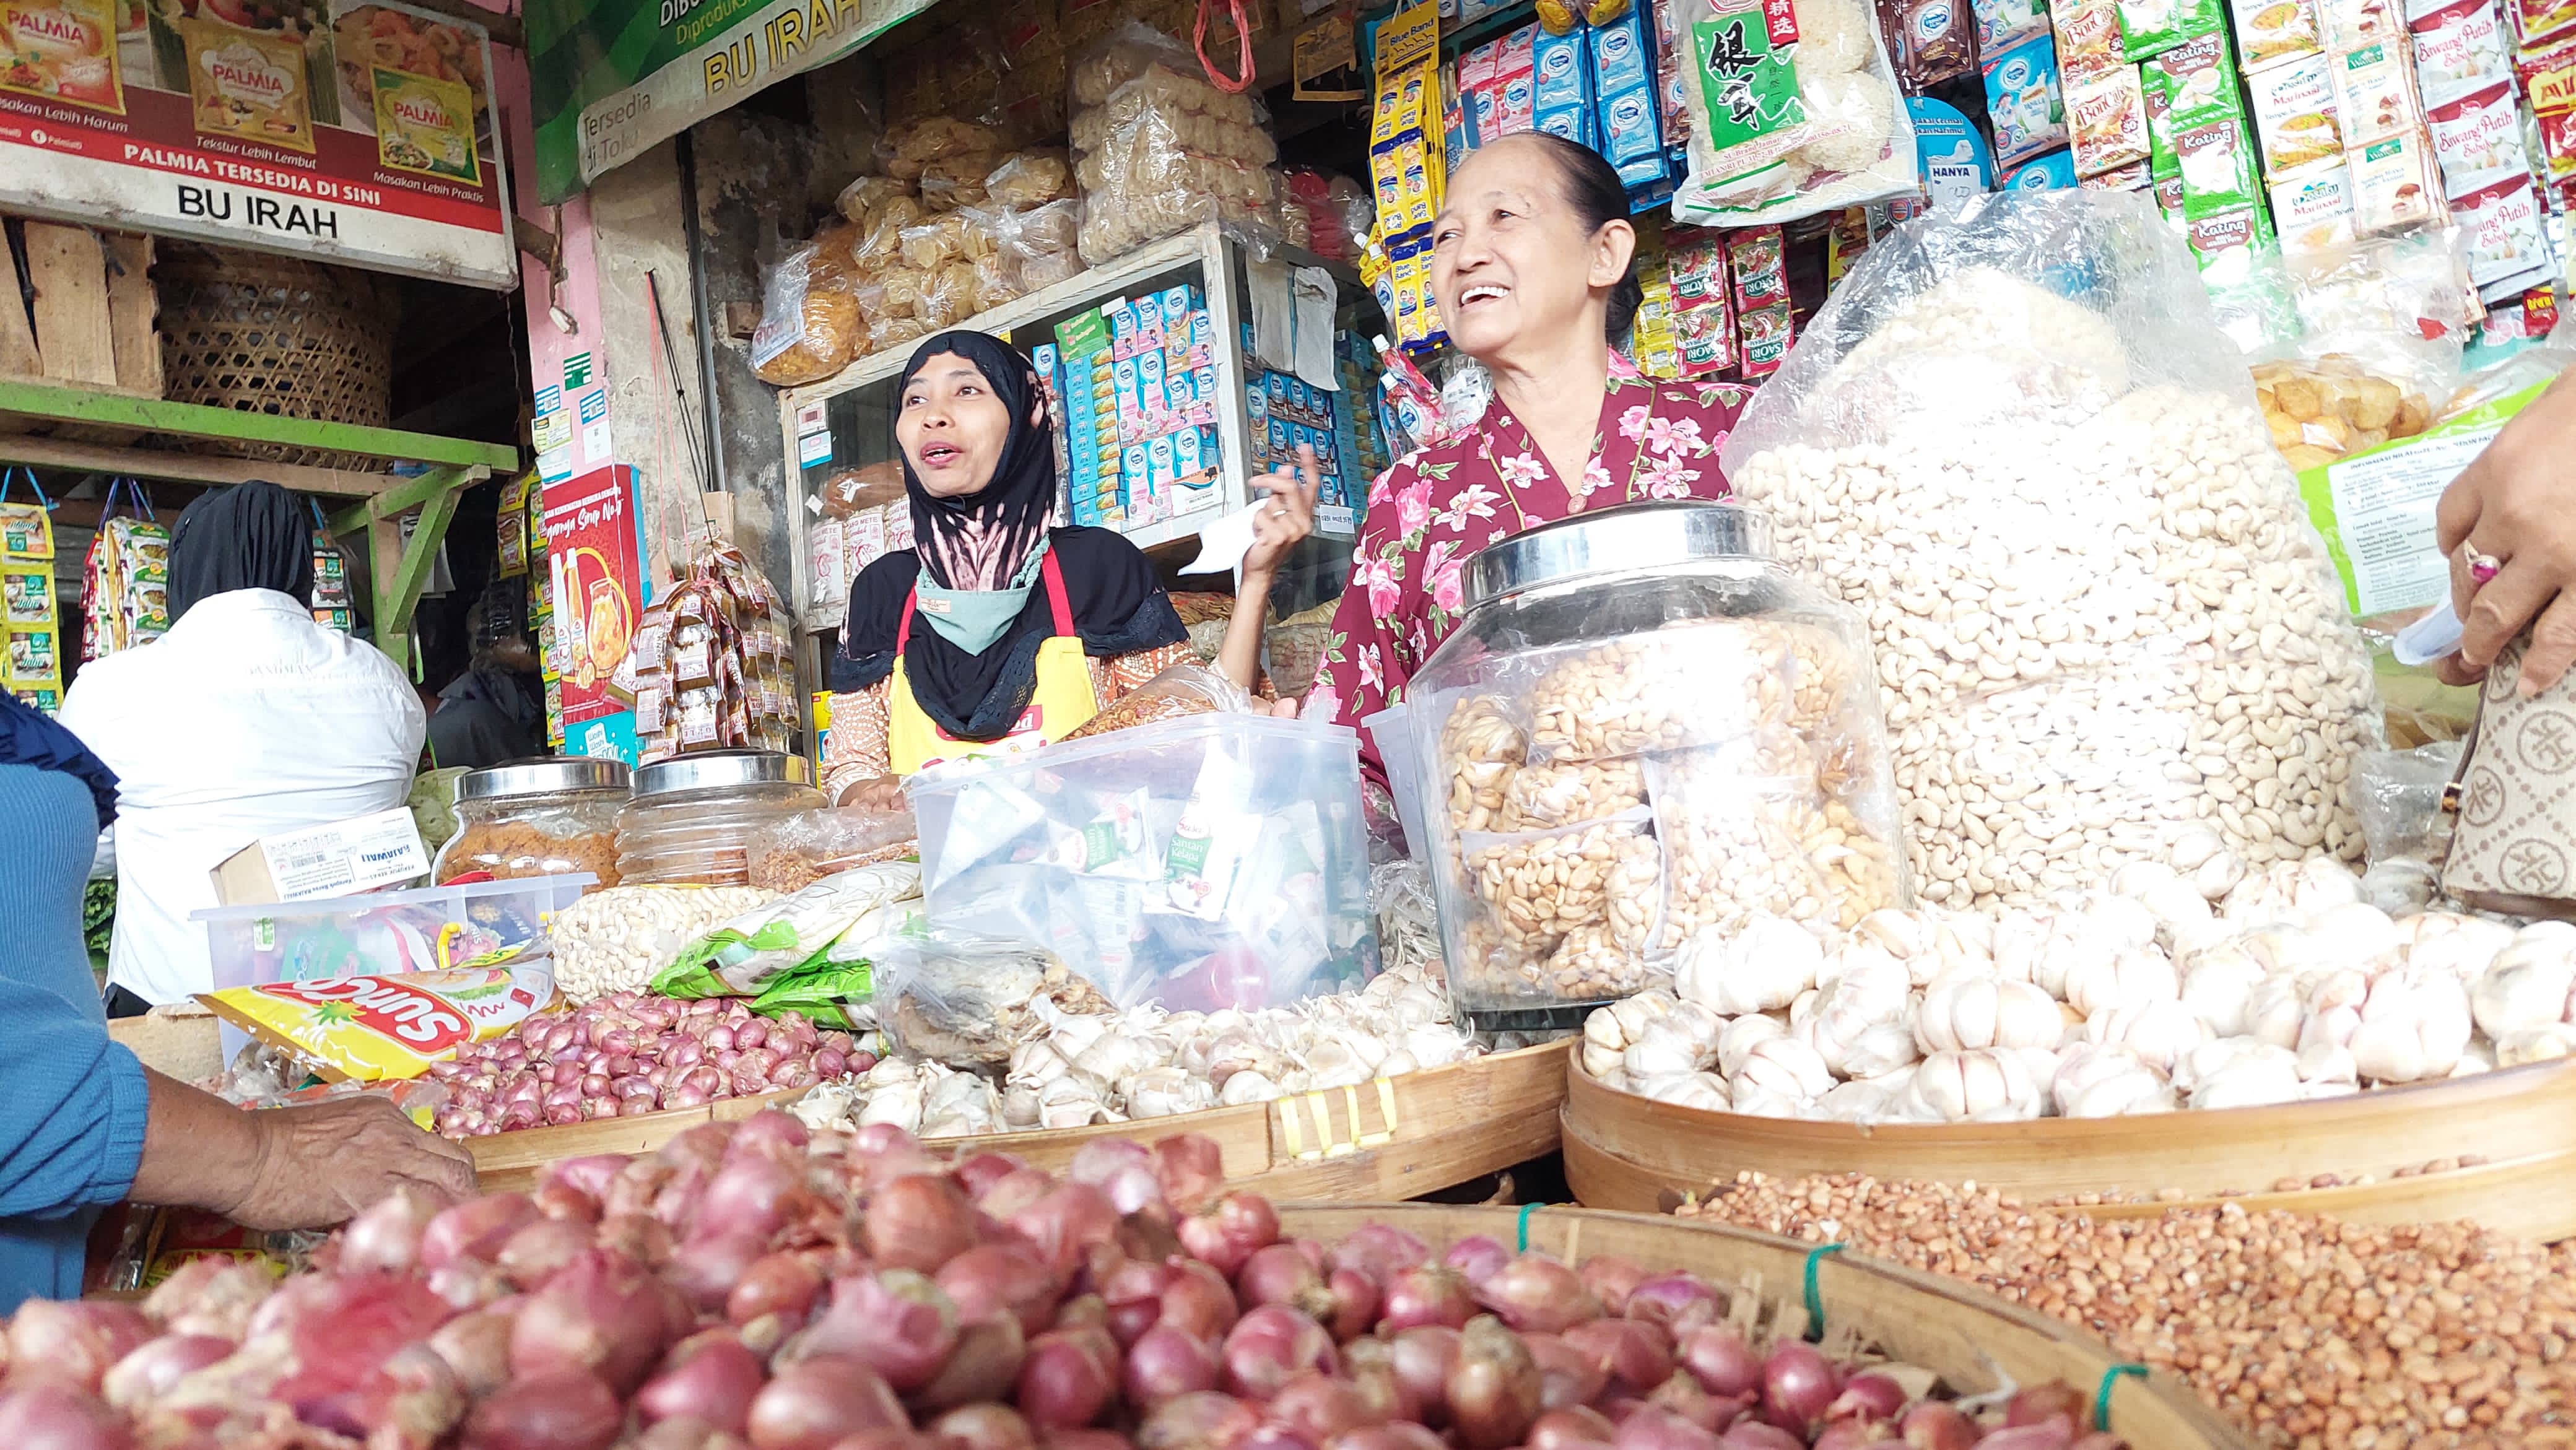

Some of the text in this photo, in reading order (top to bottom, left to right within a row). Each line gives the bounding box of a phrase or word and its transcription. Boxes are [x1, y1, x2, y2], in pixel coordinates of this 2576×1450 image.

[7, 9, 84, 45] PALMIA
[676, 0, 751, 45] Diproduks
[1390, 18, 1434, 46] Blue Band
[703, 0, 862, 97] BU IRAH
[212, 64, 285, 93] PALMIA
[45, 105, 80, 124] Lebih
[84, 115, 129, 132] Harum
[393, 101, 456, 127] PALMIA
[583, 93, 651, 141] Tersedia
[196, 135, 316, 170] Tekstur Lebih Lembut
[2183, 128, 2232, 150] Kating
[124, 142, 381, 206] PALMIA TERSEDIA DI SINI
[1933, 165, 1970, 178] HANYA
[373, 171, 484, 203] Masakan Lebih Praktis
[178, 185, 338, 239] BU IRAH
[2197, 218, 2248, 241] Kating
[1679, 279, 1707, 295] AORI
[1751, 342, 1783, 358] SAORI
[859, 516, 878, 526] METE
[360, 843, 411, 863] RAJAWALI
[1171, 836, 1204, 853] Santan
[1171, 847, 1199, 863] Kelapa
